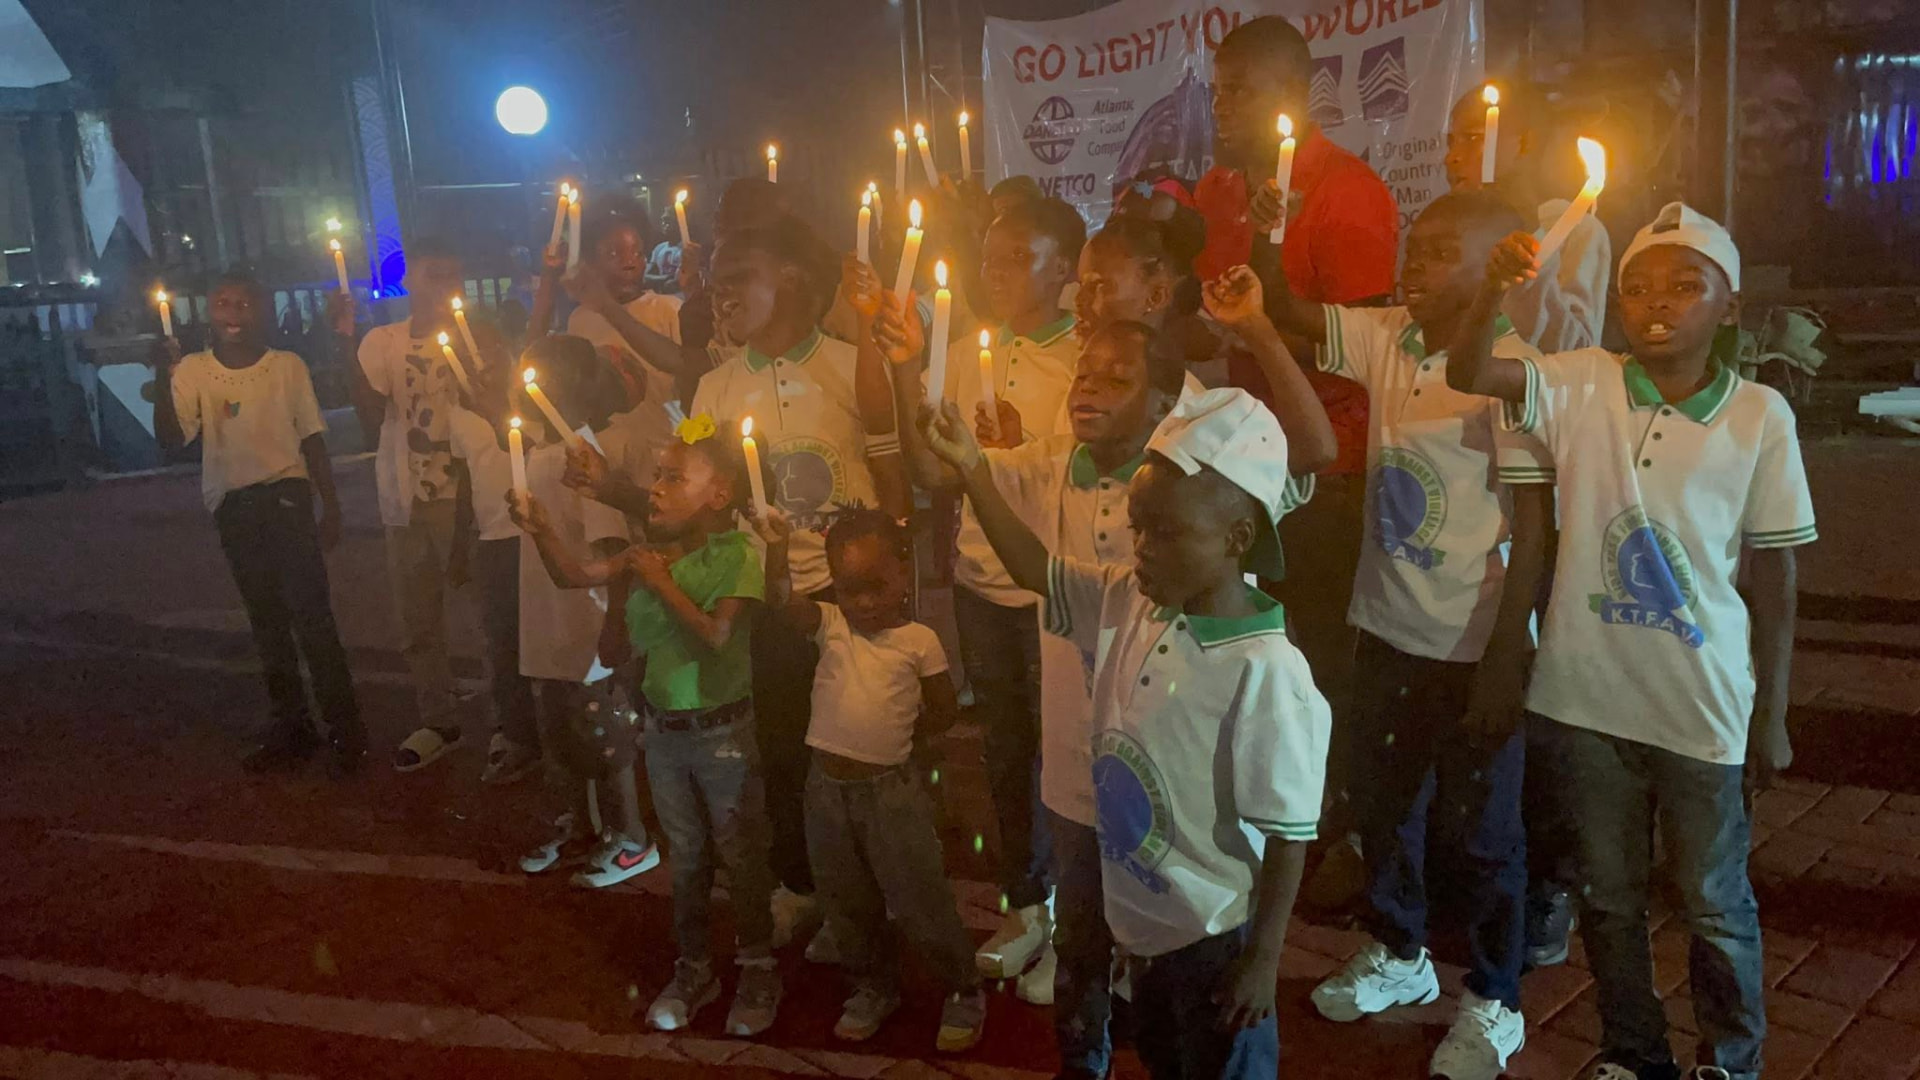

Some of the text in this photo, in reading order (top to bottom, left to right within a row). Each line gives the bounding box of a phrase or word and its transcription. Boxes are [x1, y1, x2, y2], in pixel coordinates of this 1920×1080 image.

[1013, 0, 1442, 84] GO LIGHT YO WORL
